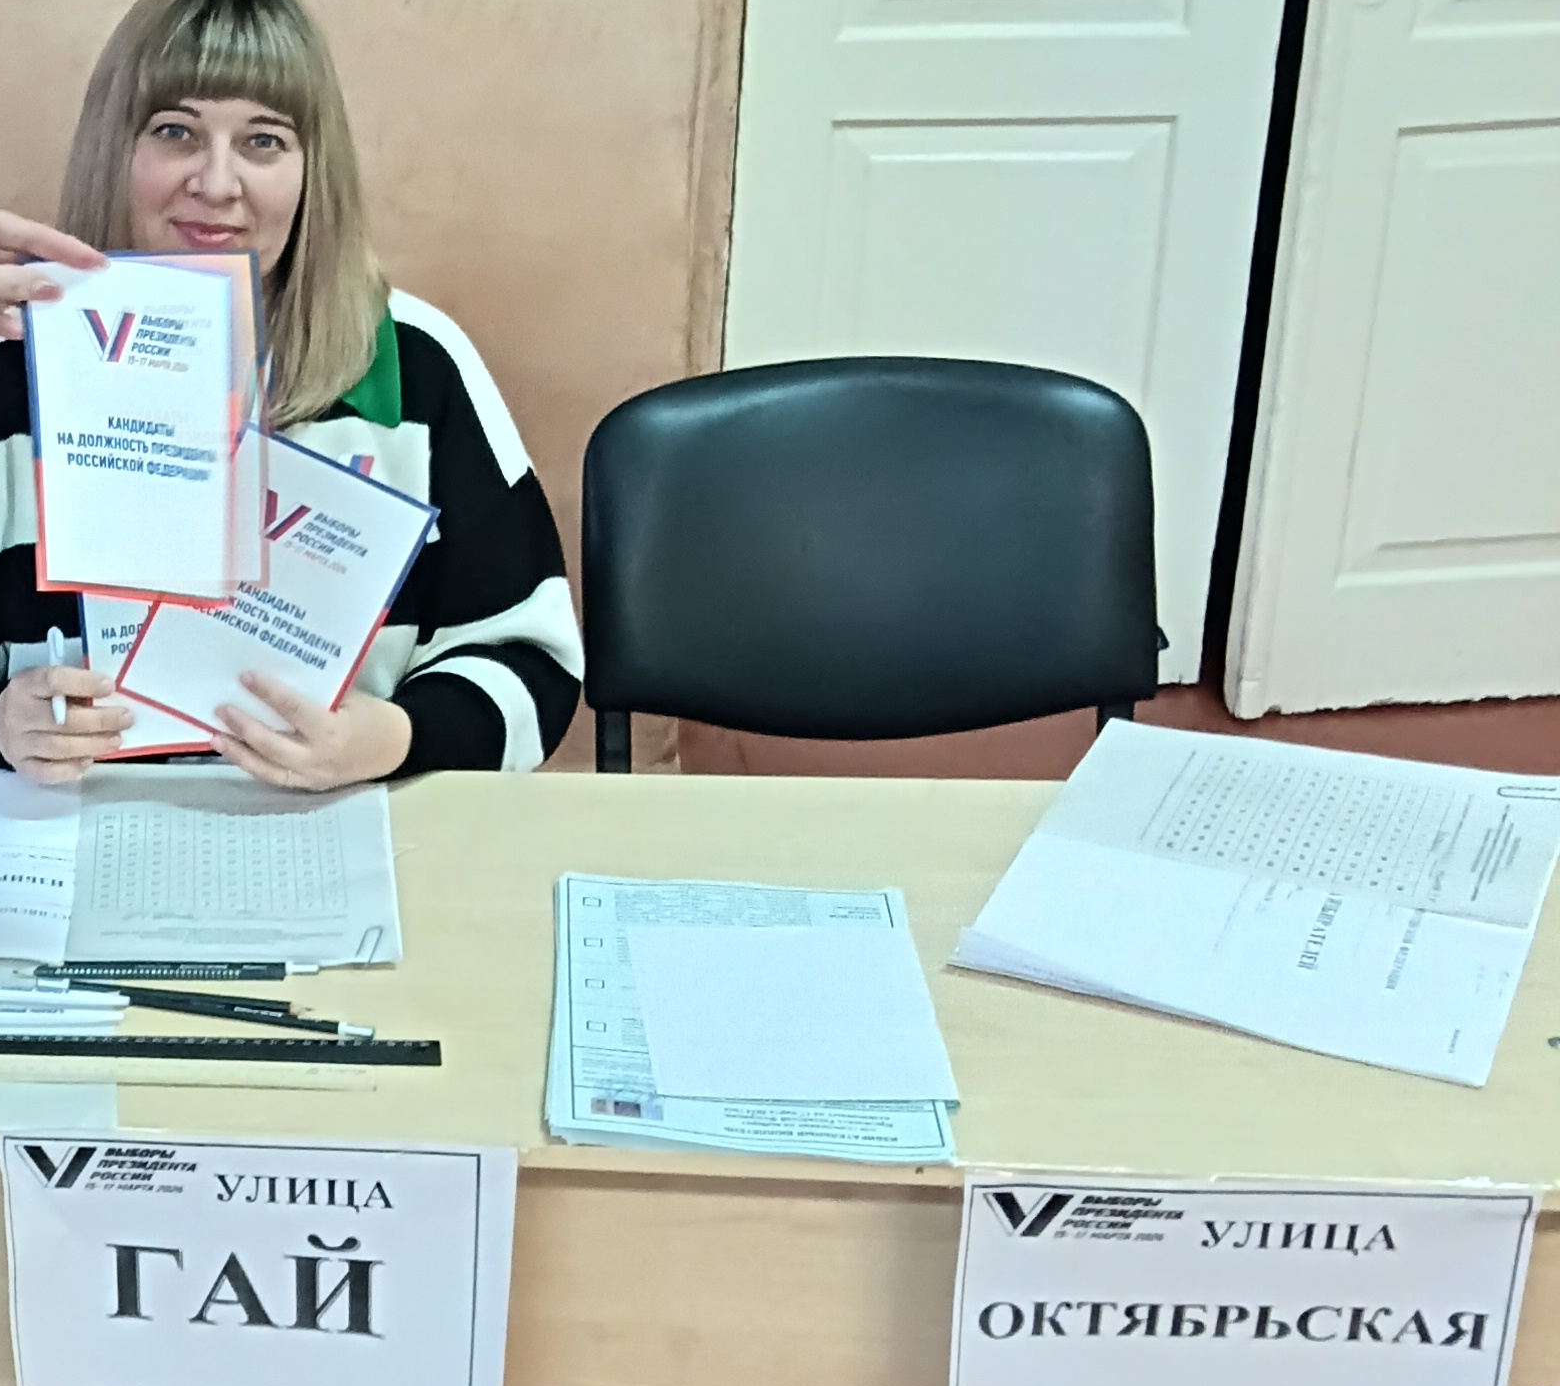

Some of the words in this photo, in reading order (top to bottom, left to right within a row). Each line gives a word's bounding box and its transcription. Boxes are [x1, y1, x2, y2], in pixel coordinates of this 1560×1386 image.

[131, 342, 172, 357] РОССИИ
[107, 415, 176, 437] КАНДИДАТЫ
[57, 432, 75, 446] НА
[77, 432, 150, 454] ДОЛЖНОСТЬ
[67, 452, 144, 473] РОССИЙСКОЙ
[313, 512, 362, 539] ВЫБОРЫ
[292, 530, 336, 556] РОССИИ
[303, 521, 369, 559] ПРЕЗИДЕНТА
[237, 580, 308, 622] КАНДИДАТЫ
[101, 626, 117, 640] НА
[271, 616, 343, 659] ПРЕЗИДЕНТА
[259, 629, 328, 671] ФЕДЕРАЦИИ
[104, 1146, 177, 1160] ВЫБОРЫ
[89, 1170, 154, 1182] РОССИИ
[96, 1158, 198, 1173] ПРЕЗИДЕНТА
[213, 1173, 396, 1214] УЛИЦА
[1081, 1194, 1164, 1207] ВЫБОРЫ
[1061, 1217, 1137, 1230] РОССИИ
[1200, 1218, 1397, 1257] УЛИЦА
[105, 1233, 388, 1341] ГАЙ
[977, 1300, 1491, 1352] ОКТЯБРЬСКАЯ
